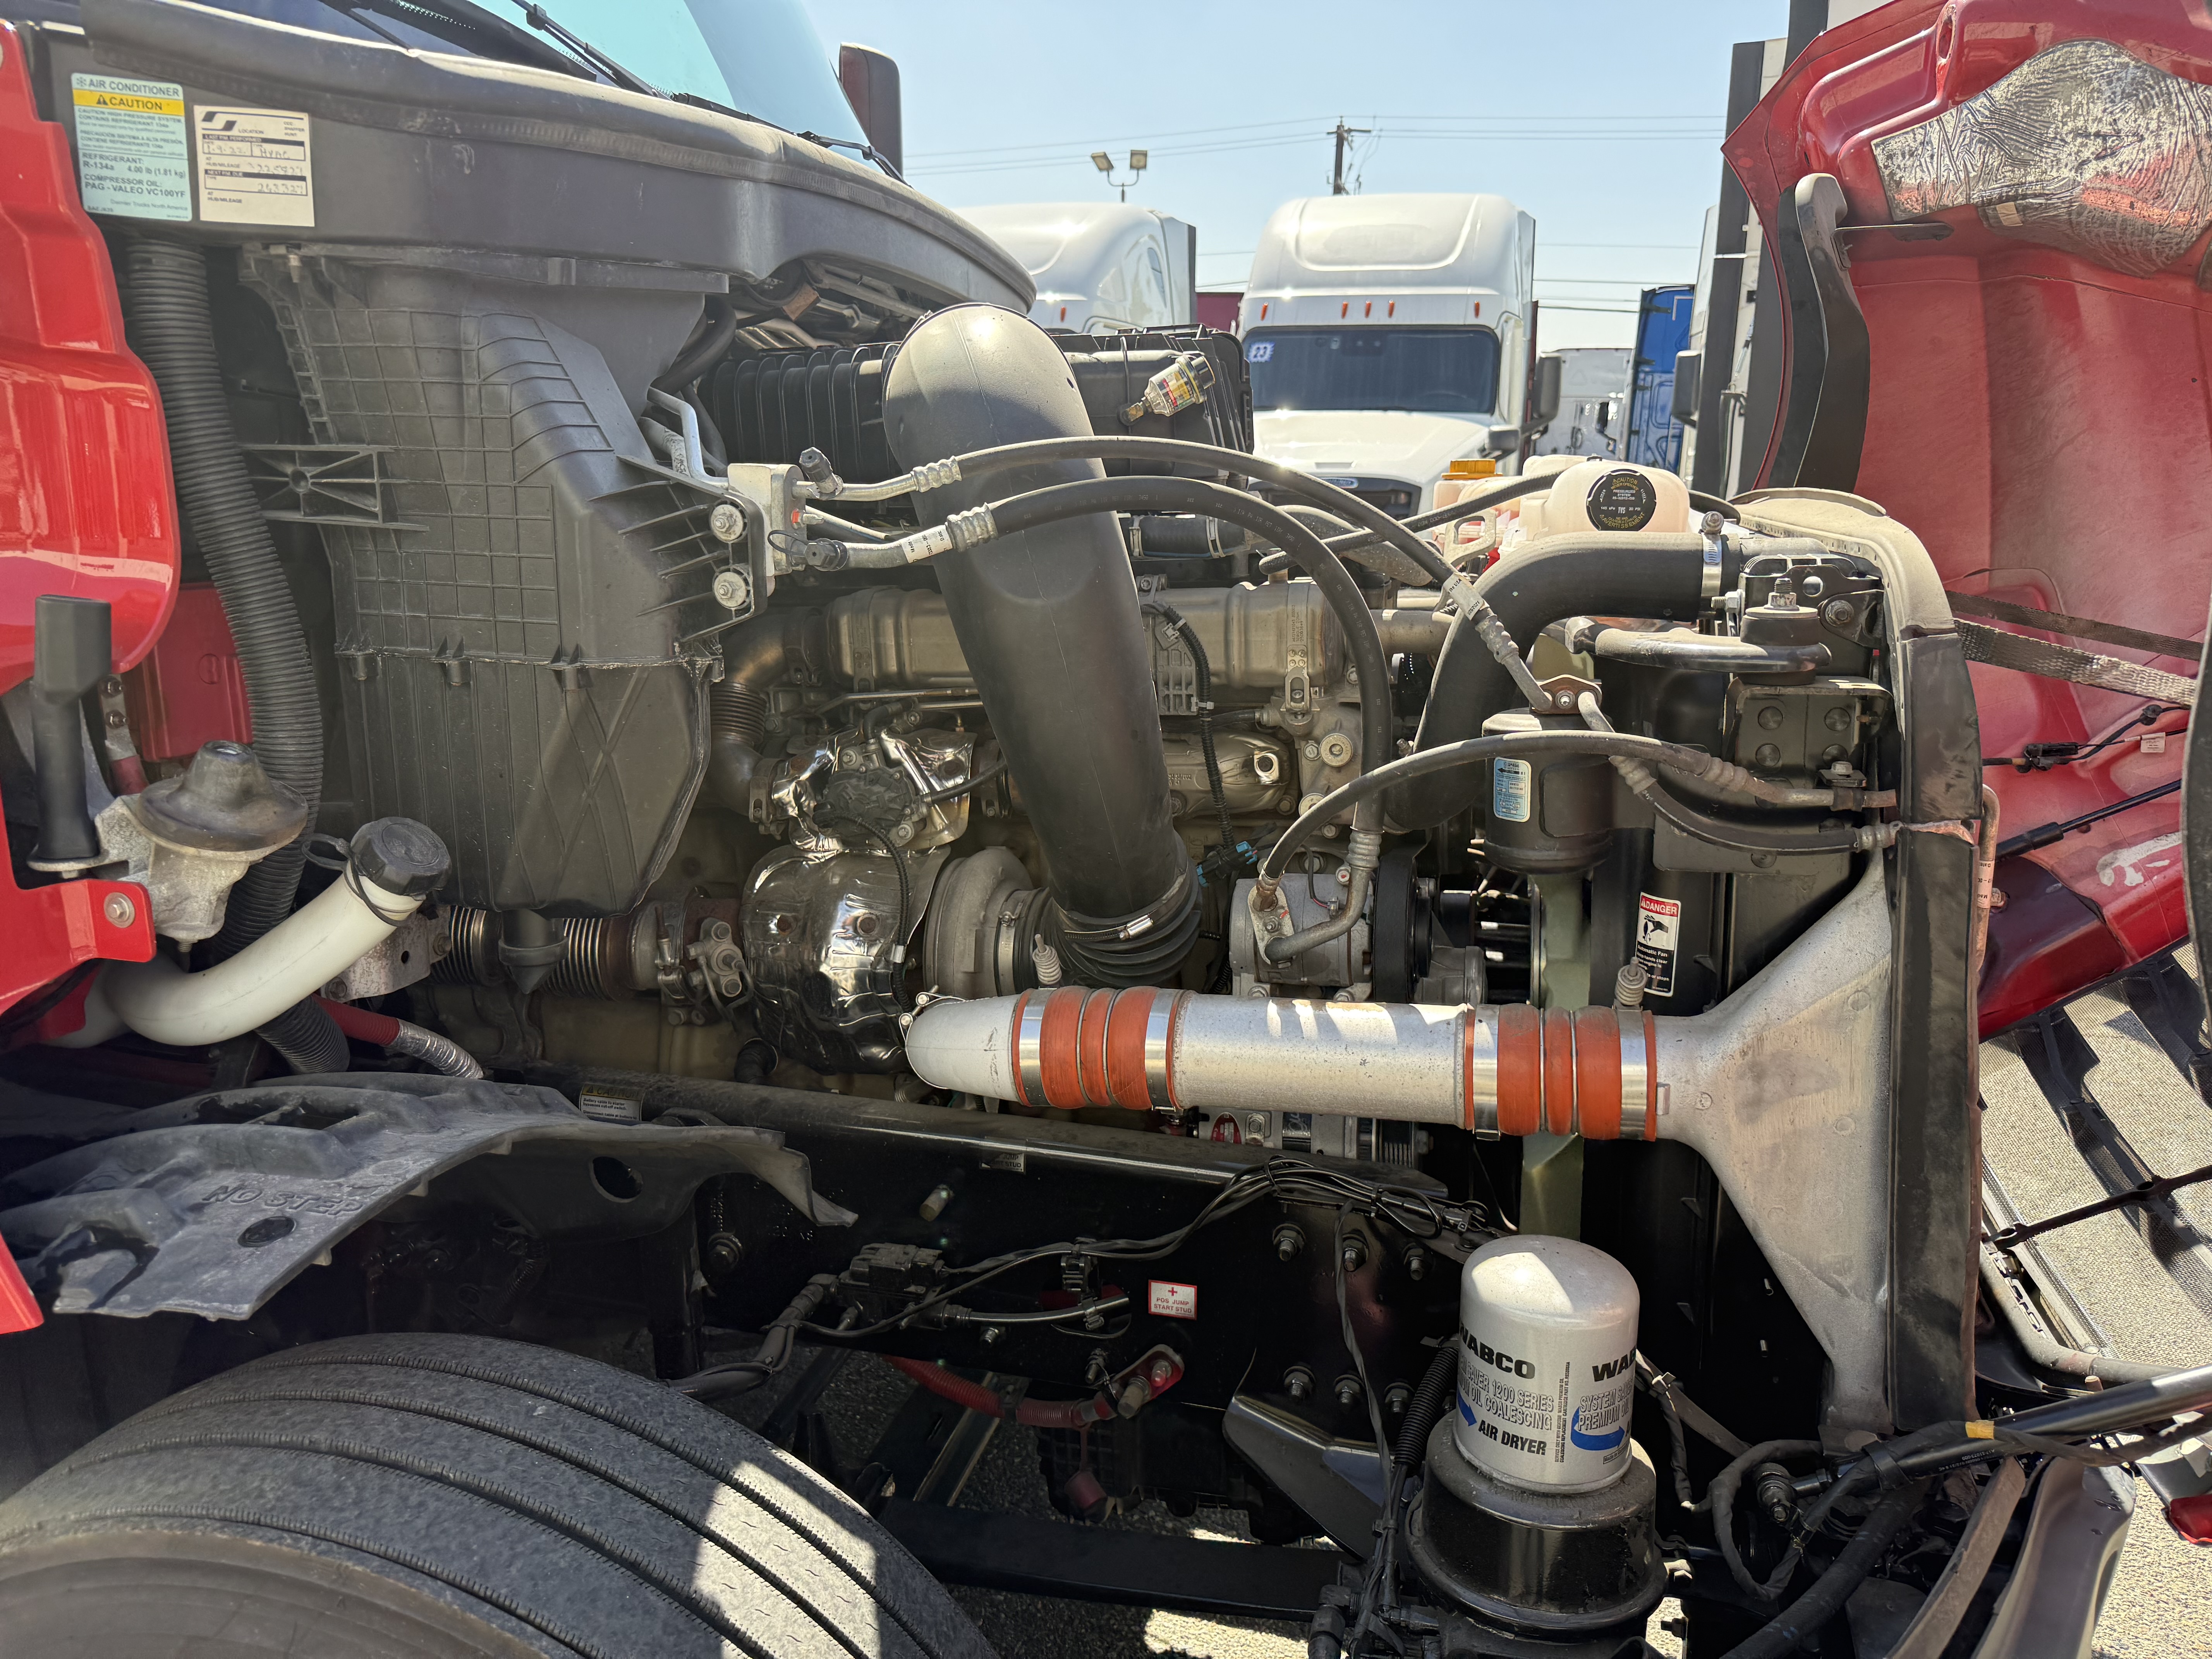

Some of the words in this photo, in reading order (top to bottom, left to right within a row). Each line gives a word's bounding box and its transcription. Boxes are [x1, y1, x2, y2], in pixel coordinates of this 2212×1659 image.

[89, 79, 106, 89] AIR
[109, 81, 179, 97] CONDITIONER
[110, 97, 163, 110] CAUTION
[82, 152, 144, 165] REFRIGERANT:
[83, 160, 114, 170] R-134a
[127, 165, 143, 173] 4.00
[155, 167, 172, 176] (1.81
[174, 170, 186, 179] kg)
[84, 174, 144, 185] COMPRESSOR
[85, 182, 105, 190] PAG
[111, 184, 143, 194] VALEO
[146, 187, 185, 198] VC100YF
[1646, 901, 1677, 914] DANGER
[1638, 945, 1657, 955] Automatic
[202, 1185, 263, 1204] NO
[264, 1192, 363, 1216] STEP
[1492, 1380, 1515, 1404] 1200
[1517, 1389, 1554, 1412] SERIES
[1580, 1389, 1616, 1413] SYSTEM
[1471, 1383, 1482, 1407] OIL
[1484, 1395, 1552, 1431] COALESCING
[1578, 1405, 1619, 1431] PREMIUM
[1478, 1420, 1498, 1441] AIR
[1501, 1431, 1547, 1455] DRYER
